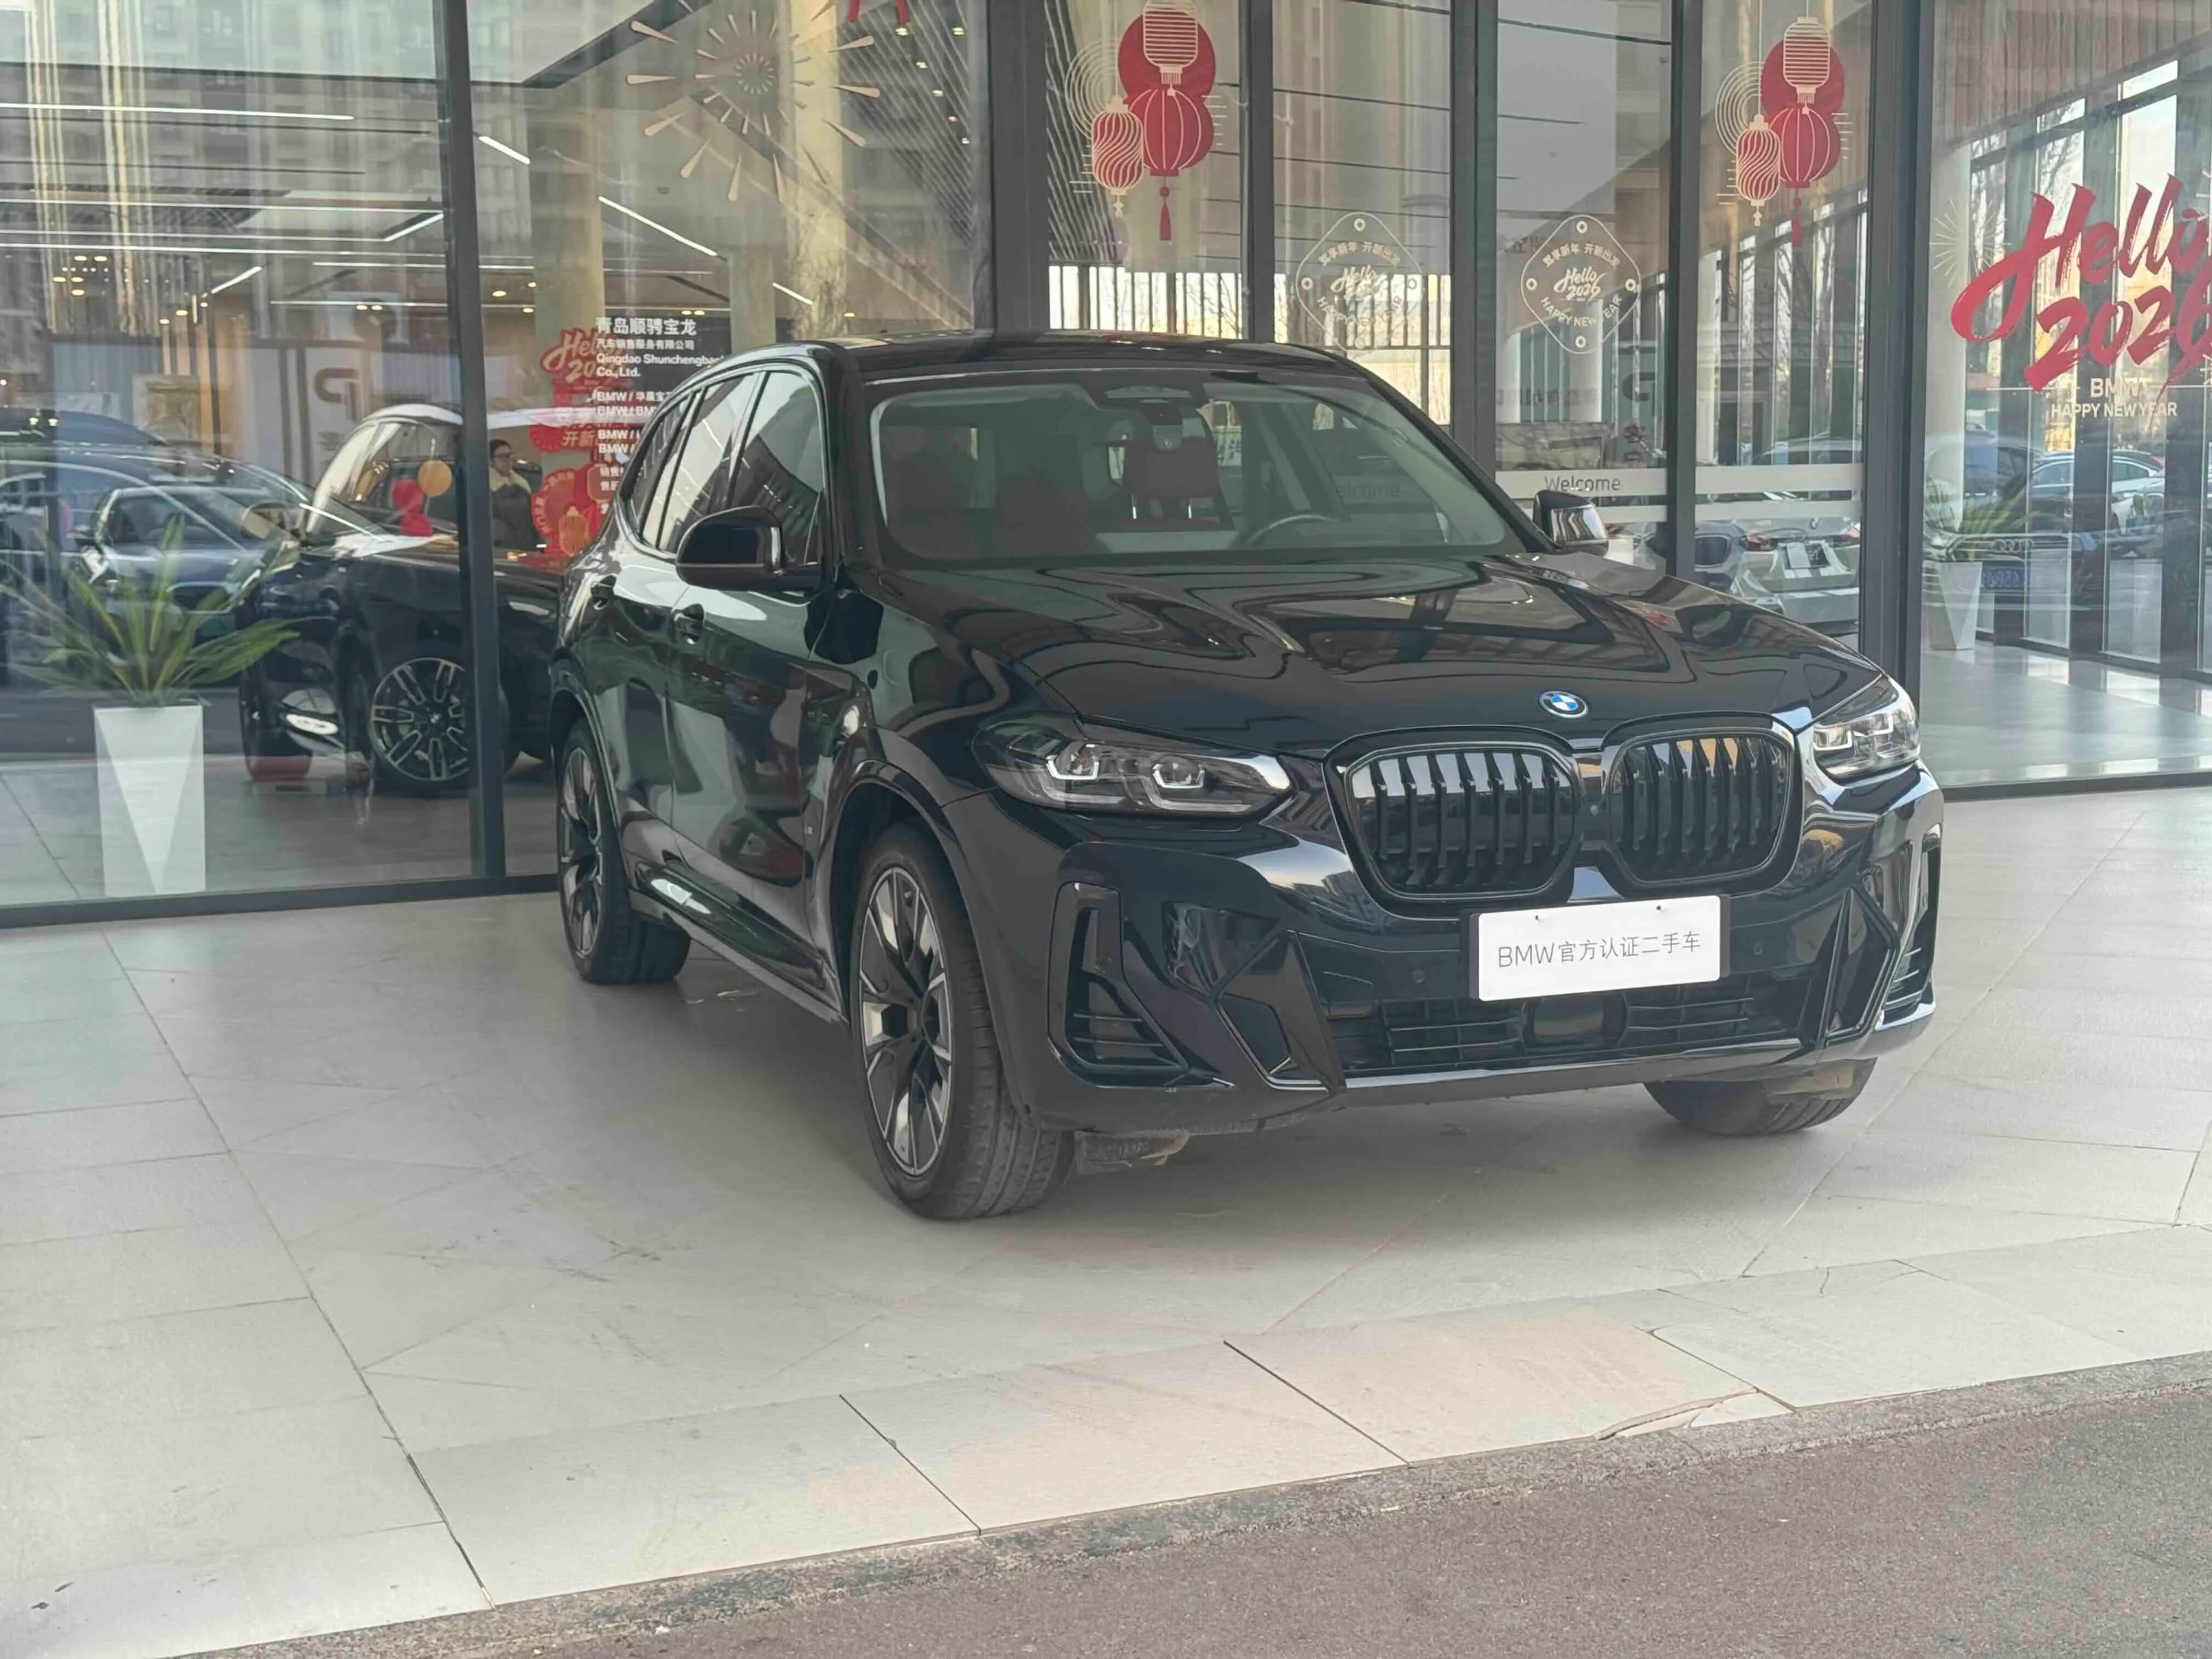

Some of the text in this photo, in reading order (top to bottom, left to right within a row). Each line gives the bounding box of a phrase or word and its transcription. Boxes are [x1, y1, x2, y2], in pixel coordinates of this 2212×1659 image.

[1951, 173, 2210, 342] Hello
[1331, 264, 1377, 293] Hello
[1554, 266, 1597, 293] Hello
[1566, 272, 1608, 302] 2026
[1541, 297, 1573, 325] HAPPY
[1574, 316, 1596, 327] NEW
[2024, 262, 2212, 429] 2026
[596, 353, 641, 366] Qingdao
[597, 391, 627, 402] BMW
[597, 406, 628, 415] BMW
[2051, 402, 2177, 418] HAPPY NEW YEAR
[597, 430, 628, 440] BMW
[599, 444, 629, 453] BMW
[1544, 475, 1621, 491] Welcome
[1498, 930, 1701, 968] BMW官方认证二手车
